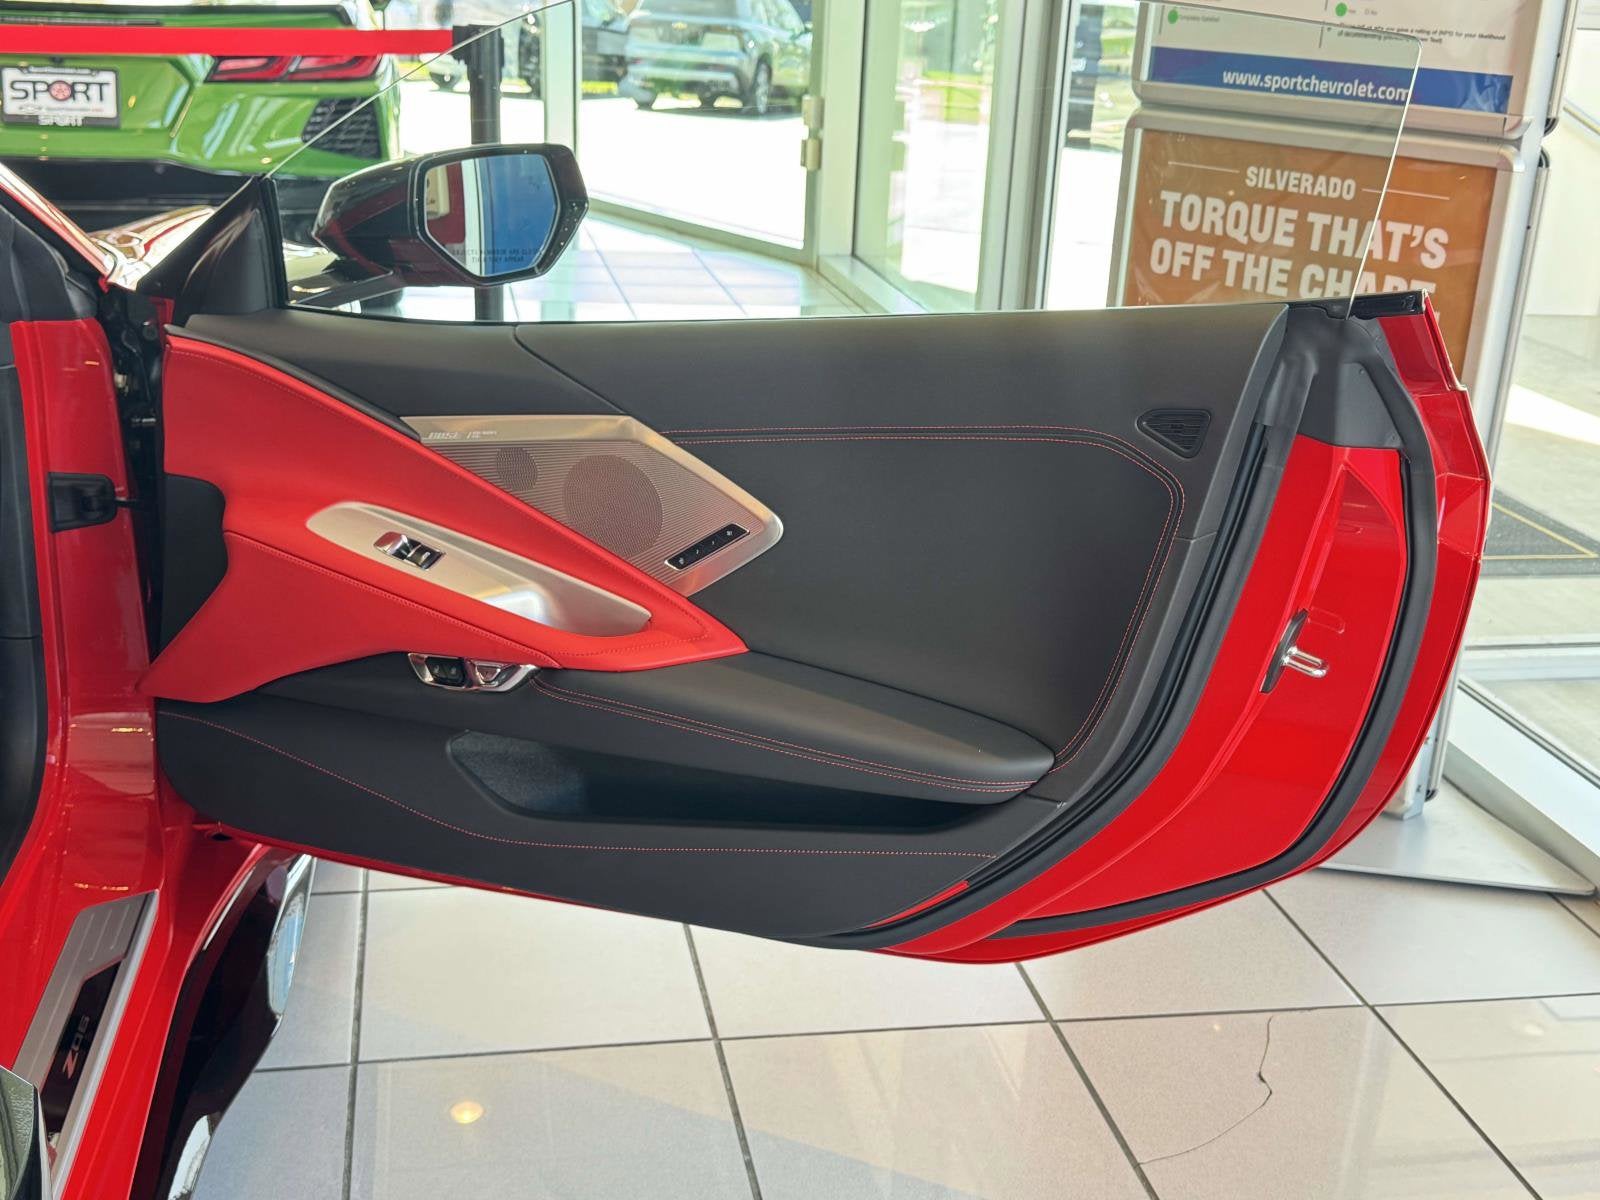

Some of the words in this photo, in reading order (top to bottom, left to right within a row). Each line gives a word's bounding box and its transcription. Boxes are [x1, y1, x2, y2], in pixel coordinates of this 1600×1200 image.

[1222, 70, 1412, 101] www.sportchevrolet.com
[1245, 166, 1356, 200] SILVERADO
[1160, 190, 1298, 247] TORQUE
[1307, 211, 1450, 269] THAT'S
[1150, 238, 1215, 282] OFF
[1222, 249, 1292, 297] THE
[62, 1014, 90, 1079] Z06
